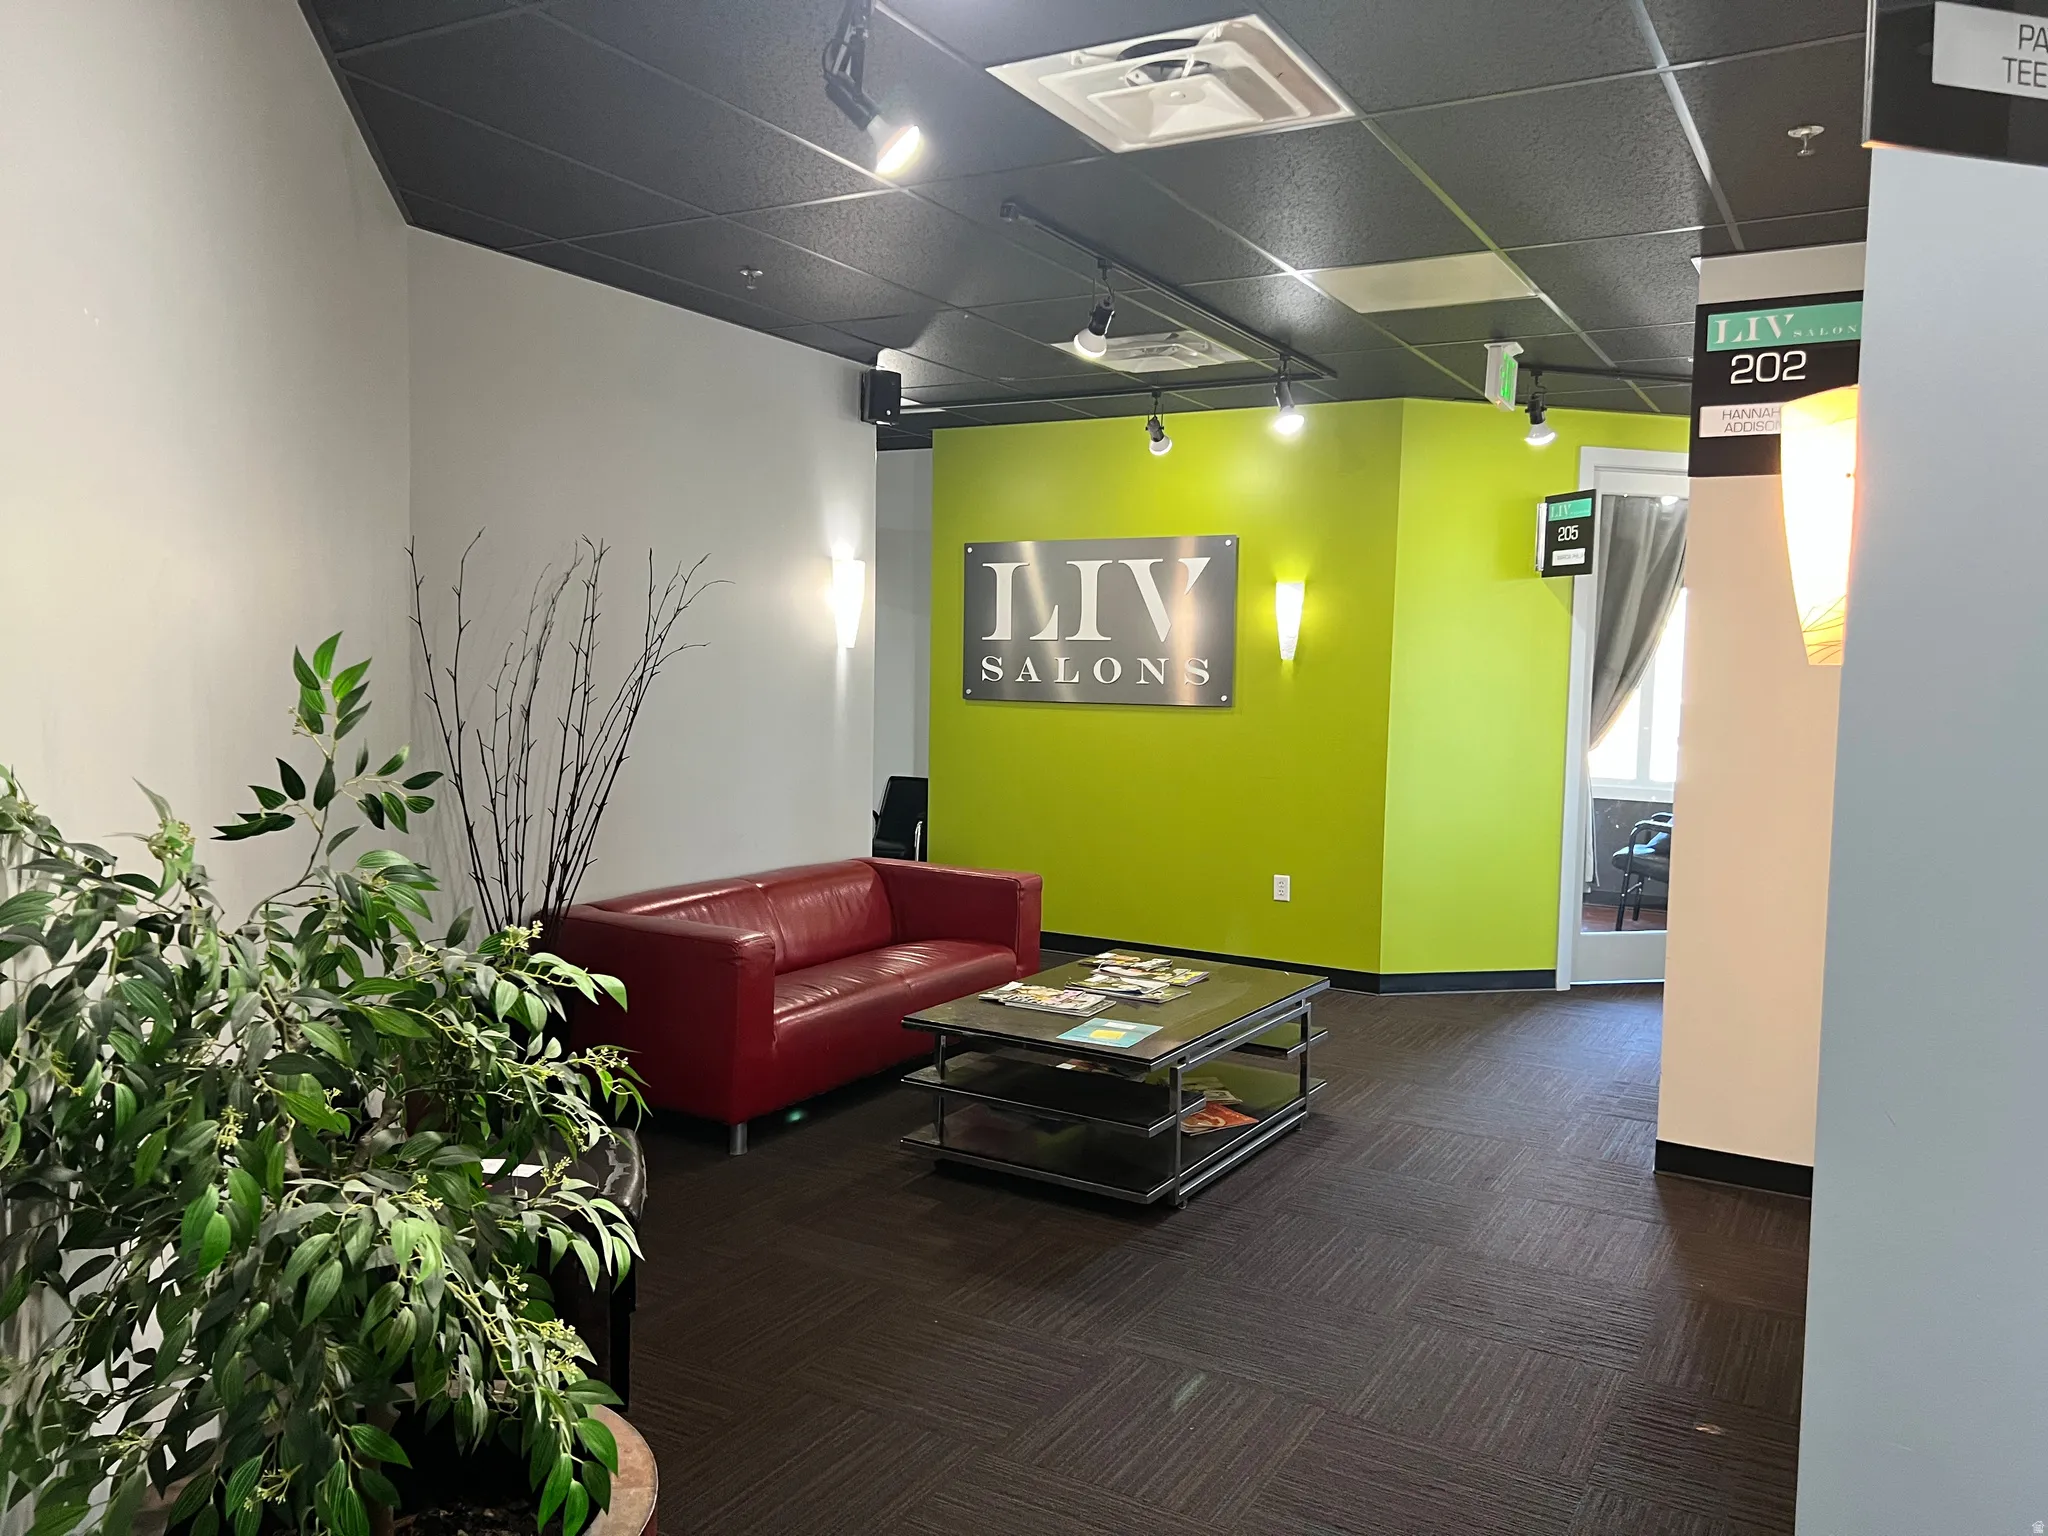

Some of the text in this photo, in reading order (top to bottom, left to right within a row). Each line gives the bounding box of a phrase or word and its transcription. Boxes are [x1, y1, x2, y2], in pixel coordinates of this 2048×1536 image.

[2001, 56, 2047, 88] TEE
[1715, 313, 1795, 344] LIV
[1730, 350, 1807, 384] 202
[1722, 407, 1781, 420] HANNAH
[1551, 503, 1572, 518] LIV
[1557, 524, 1579, 542] 205
[981, 557, 1211, 642] LIV
[981, 655, 1211, 686] SALONS
